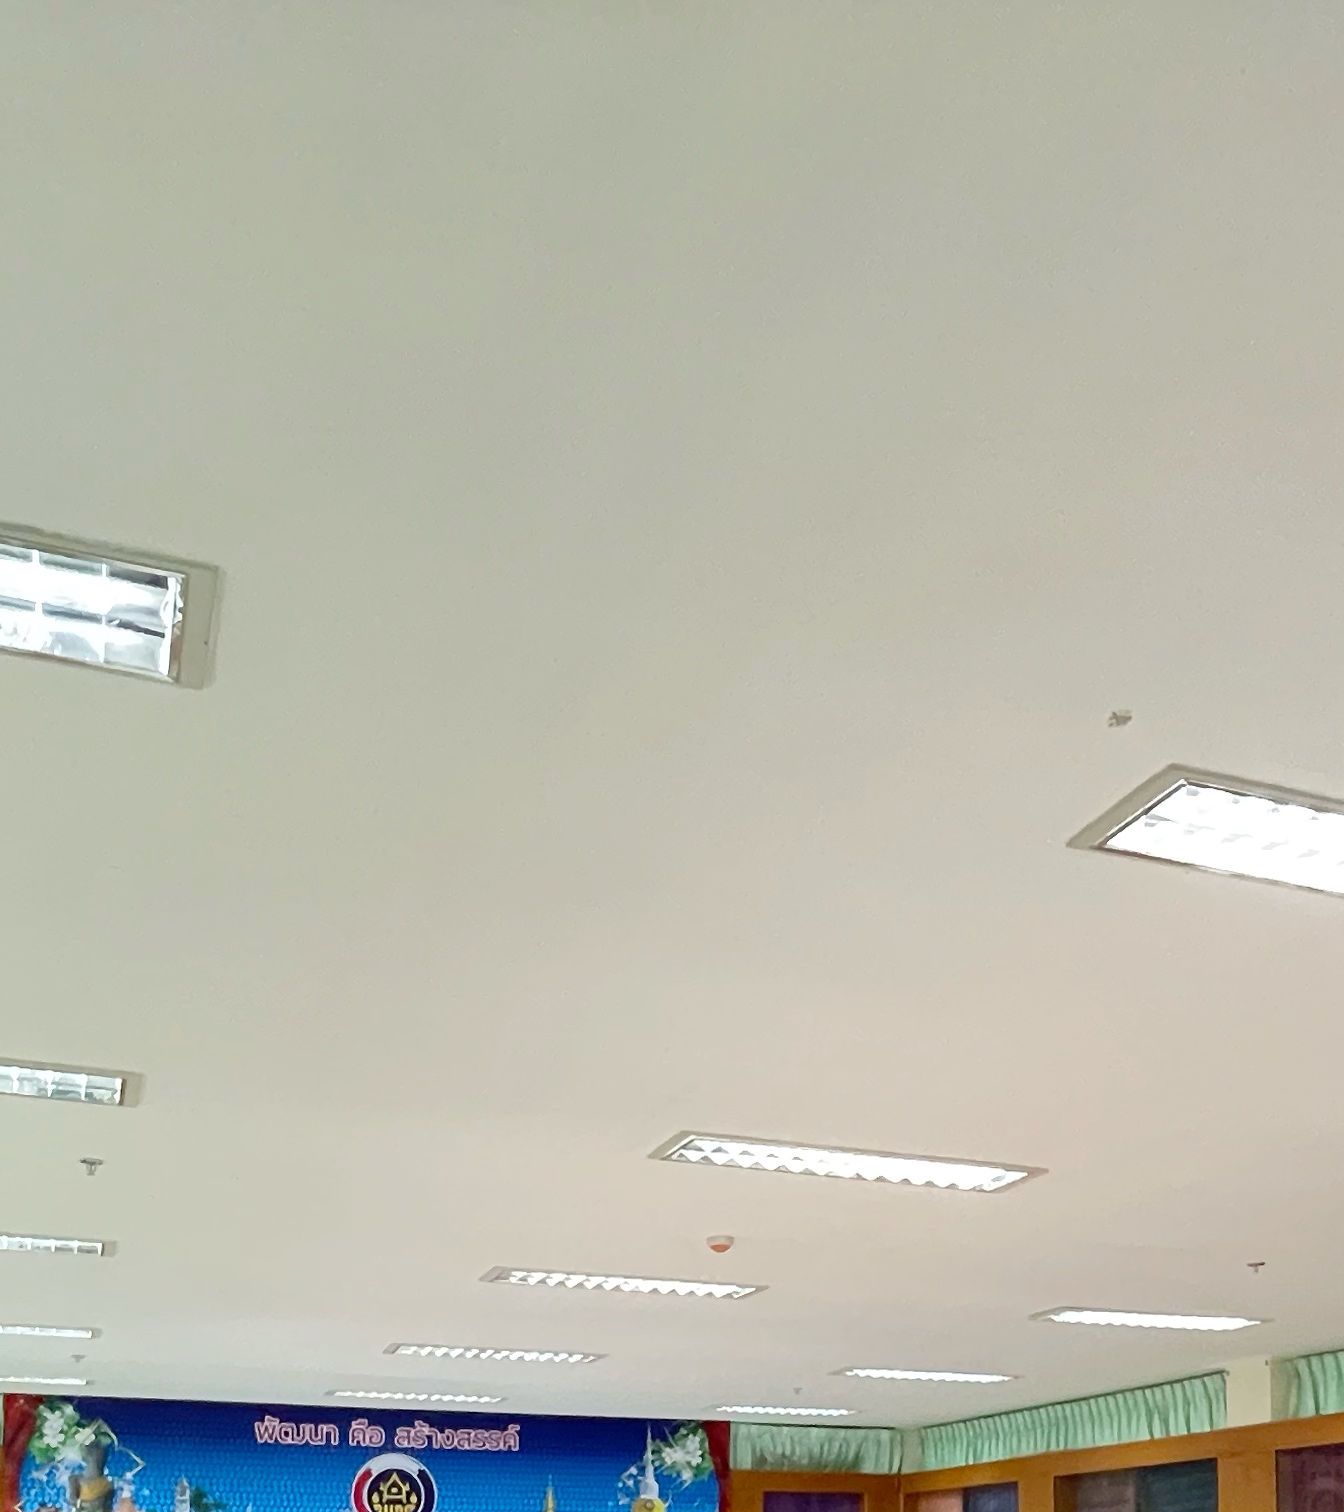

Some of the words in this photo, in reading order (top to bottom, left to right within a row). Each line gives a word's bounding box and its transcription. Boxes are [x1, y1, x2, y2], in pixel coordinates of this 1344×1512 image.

[255, 1415, 339, 1446] พัฒนา
[349, 1418, 385, 1447] คือ
[394, 1420, 521, 1451] สร้างสรรค์
